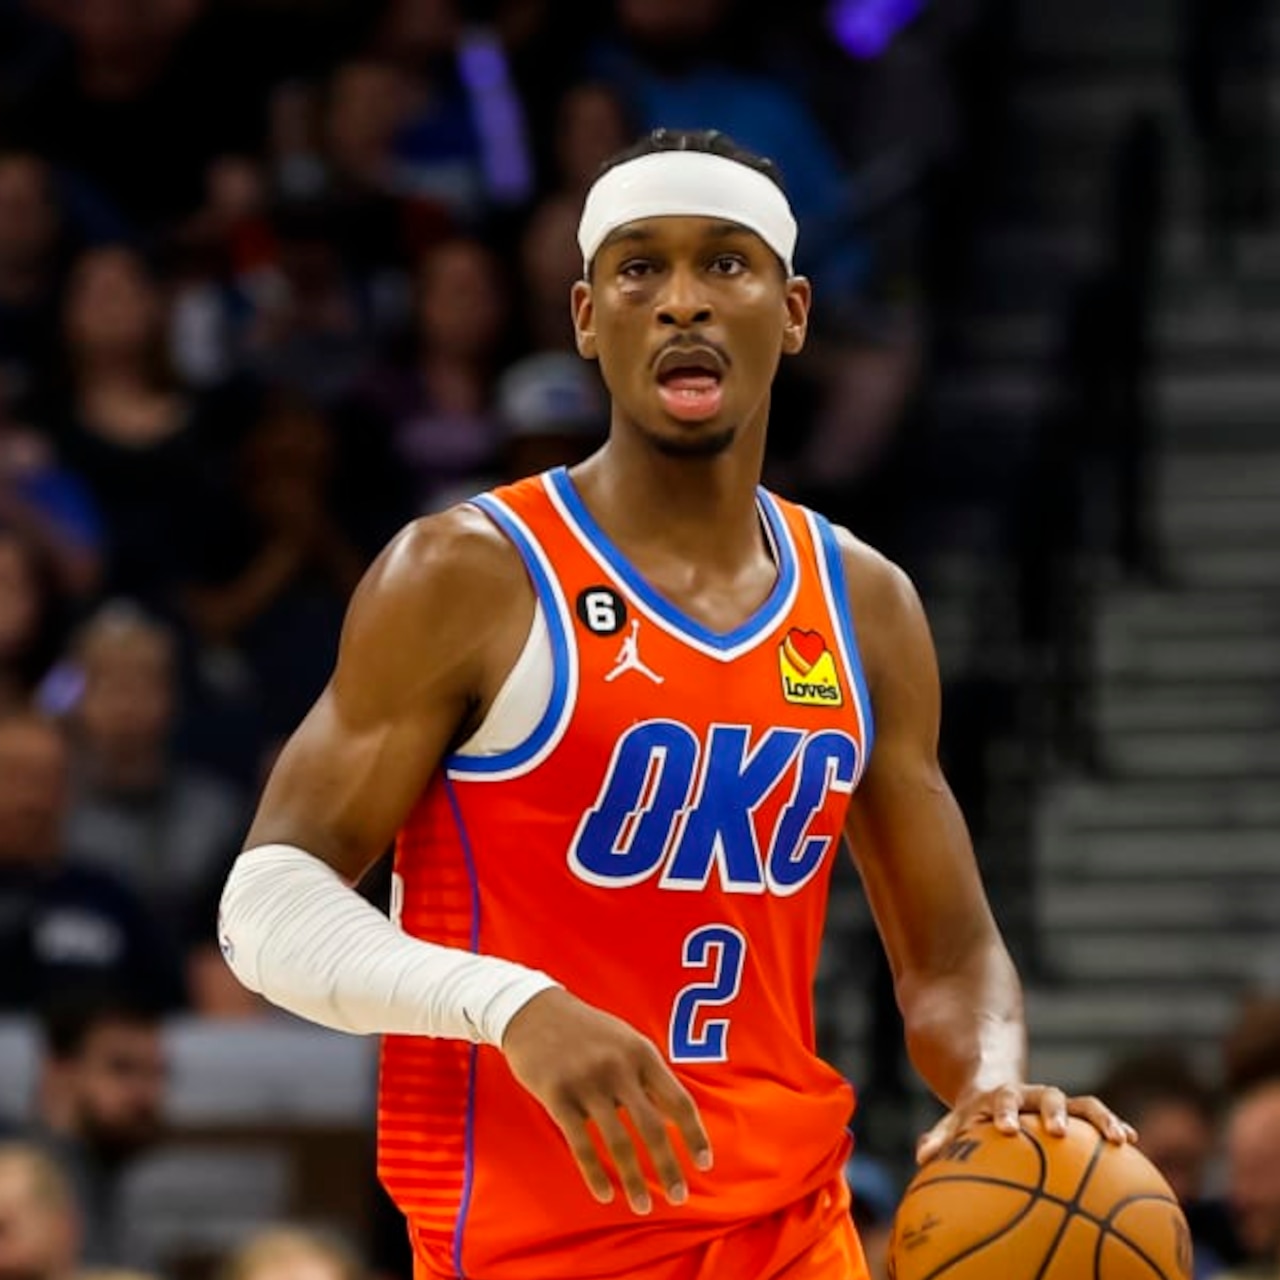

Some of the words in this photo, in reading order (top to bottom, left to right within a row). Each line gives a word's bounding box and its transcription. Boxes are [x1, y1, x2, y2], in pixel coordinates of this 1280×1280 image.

[585, 591, 617, 632] 6
[567, 717, 859, 898] OKC
[669, 923, 747, 1064] 2
